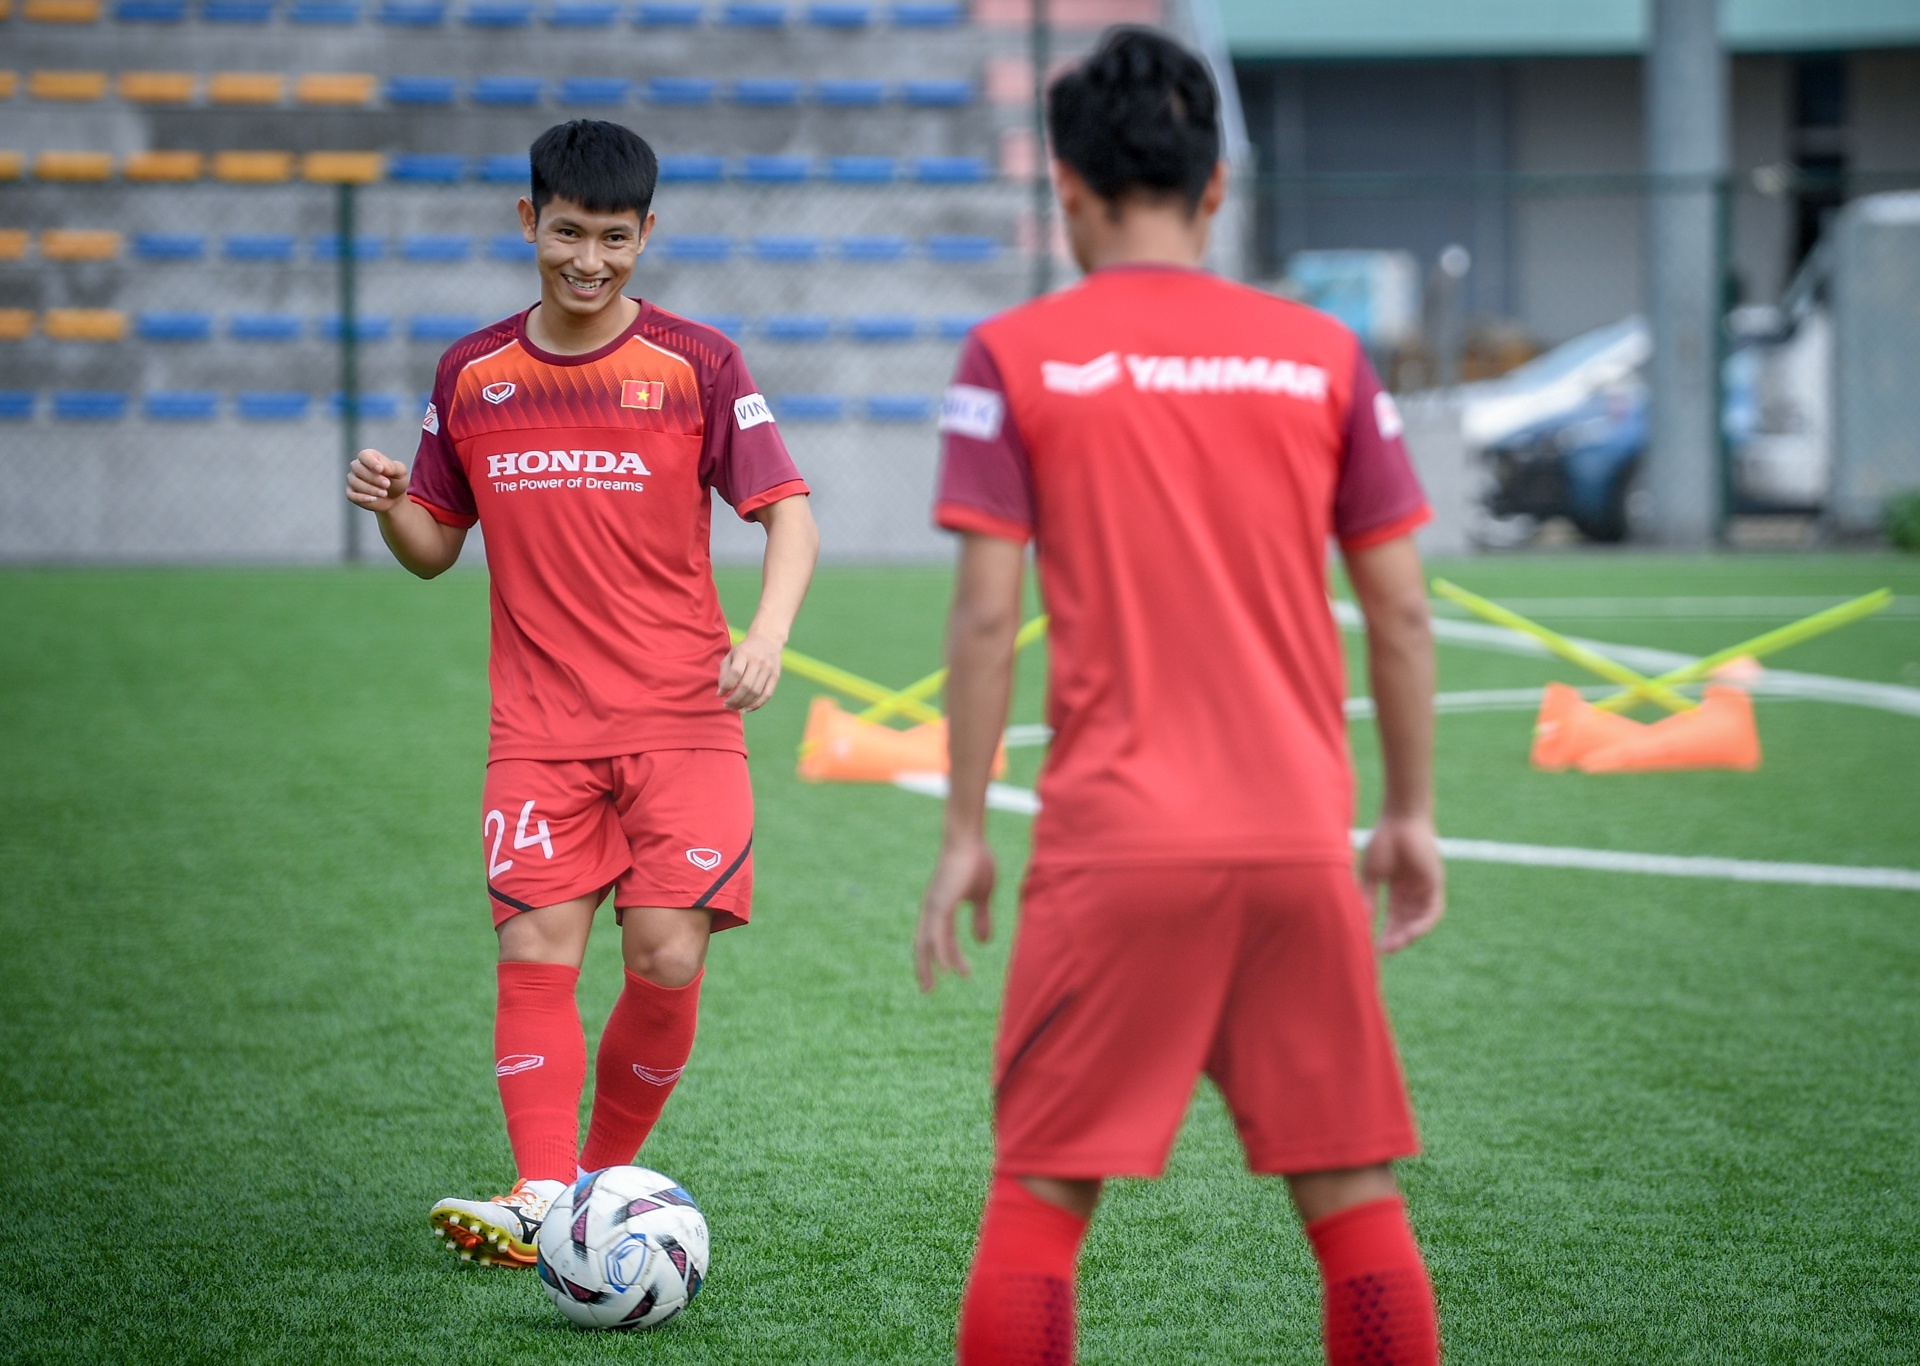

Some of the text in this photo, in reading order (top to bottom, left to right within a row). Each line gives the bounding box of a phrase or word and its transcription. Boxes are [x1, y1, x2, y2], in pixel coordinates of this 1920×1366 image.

[1126, 354, 1327, 402] YANMAR
[486, 450, 651, 477] HONDA
[493, 477, 643, 493] The Power of Dreams
[484, 800, 553, 880] 24
